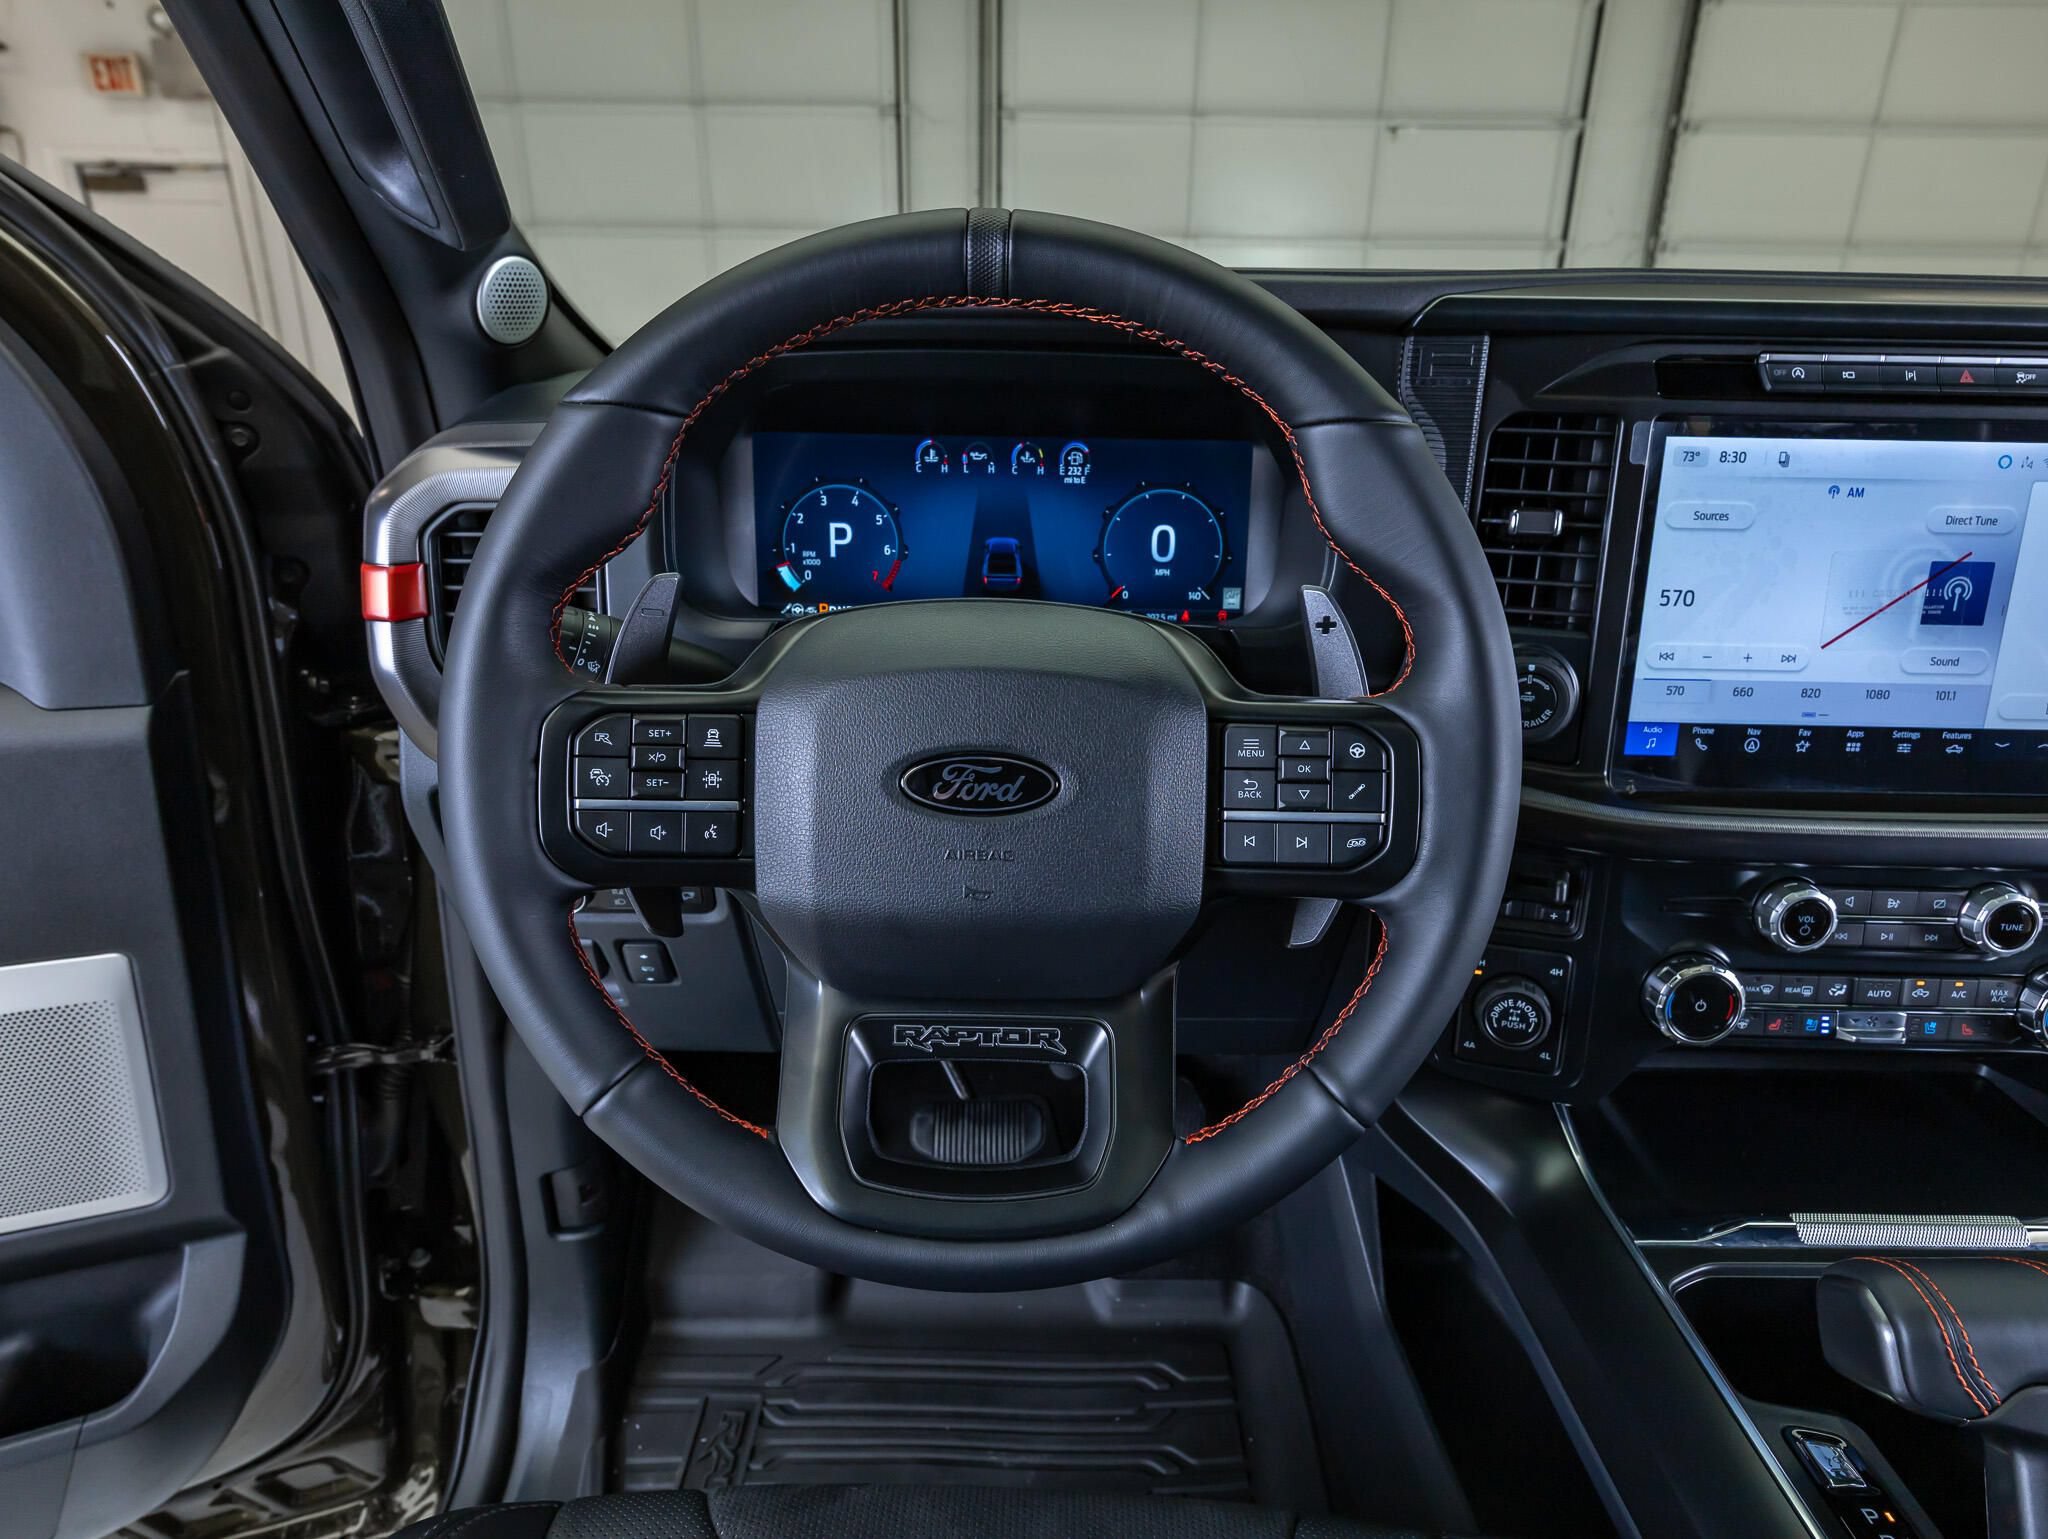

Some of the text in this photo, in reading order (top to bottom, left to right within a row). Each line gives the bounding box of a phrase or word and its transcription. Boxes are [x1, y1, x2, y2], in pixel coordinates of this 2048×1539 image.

[1719, 450, 1747, 464] 8:30
[915, 464, 948, 473] C H
[963, 464, 995, 473] L H
[1011, 466, 1044, 475] C H
[1059, 466, 1065, 476] E
[1067, 466, 1082, 476] 232
[1846, 487, 1865, 498] AM
[820, 495, 827, 506] 3
[851, 495, 859, 507] 4
[797, 513, 804, 524] 2
[875, 514, 883, 525] 5
[1693, 510, 1730, 521] Sources
[1945, 515, 1999, 526] Direct Tune
[829, 522, 853, 558] P
[1151, 524, 1176, 563] 0
[883, 544, 891, 556] 6
[804, 570, 812, 580] 0
[872, 570, 879, 581] 7
[1155, 568, 1170, 577] MPH
[1122, 590, 1129, 600] 0
[1188, 591, 1202, 600] 140
[1659, 589, 1695, 607] 570
[1929, 656, 1960, 667] Sound
[1665, 685, 1957, 701] 570 660 820 1080 101.1
[648, 729, 672, 738] SET+
[1643, 726, 1973, 740] Audio Phone Nav Fav Apps Settings Features
[1237, 749, 1265, 758] MENU
[1297, 764, 1312, 773] OK
[931, 763, 1027, 802] Ford
[1237, 790, 1262, 799] BACK
[943, 849, 1016, 862] AIRBAG
[1798, 916, 1816, 924] VOL
[2000, 923, 2025, 931] TUNE
[1549, 967, 1564, 977] 4H
[1785, 986, 1801, 994] REAR
[1867, 989, 1892, 998] AUTO
[1951, 990, 1967, 999] A/C
[1490, 999, 1538, 1023] DRIVE MODE
[1501, 1020, 1526, 1030] PUSH
[893, 1024, 1068, 1055] RAPTOR
[1463, 1040, 1476, 1049] 4A
[1539, 1052, 1551, 1061] 4L
[1860, 1507, 1880, 1525] P
